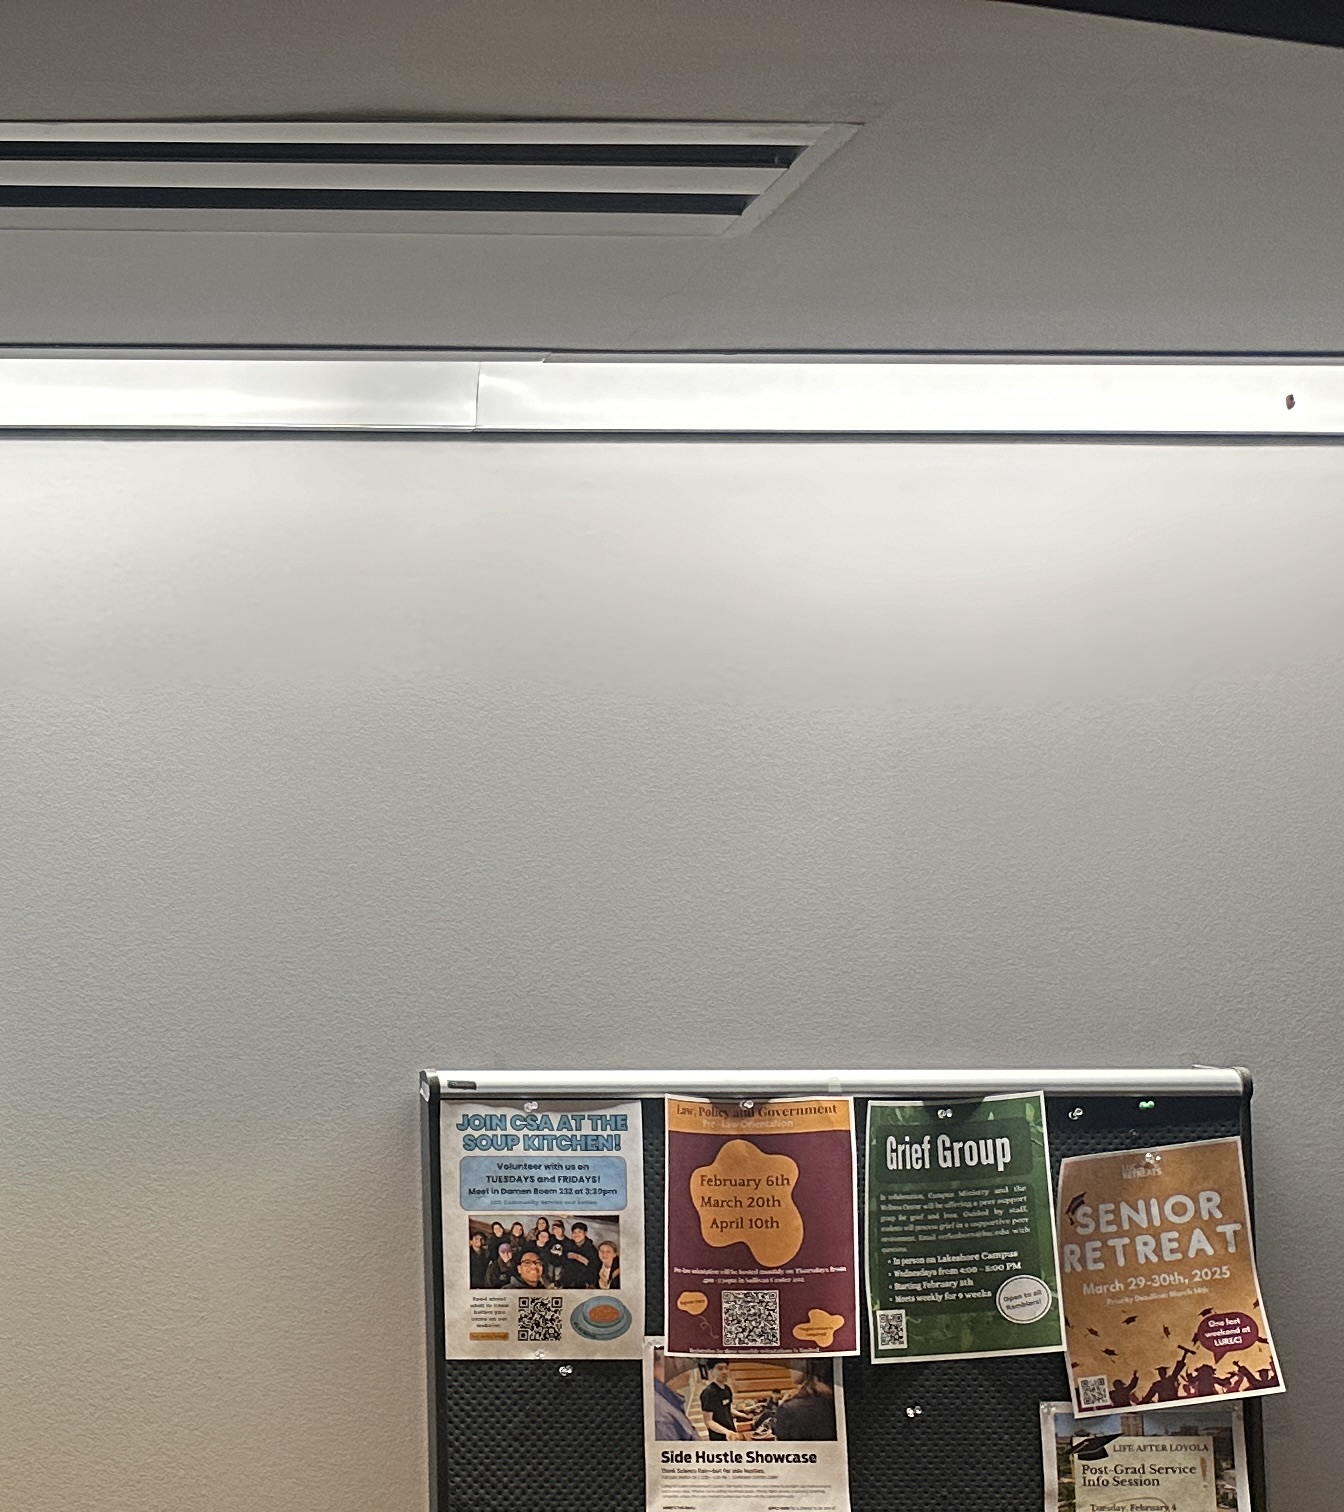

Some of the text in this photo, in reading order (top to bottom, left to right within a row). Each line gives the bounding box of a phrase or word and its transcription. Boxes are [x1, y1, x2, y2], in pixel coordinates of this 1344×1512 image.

[677, 1105, 696, 1117] Law,
[699, 1106, 728, 1119] Policy
[759, 1105, 837, 1117] Government
[457, 1114, 628, 1132] JOIN CSA AT THE
[463, 1135, 621, 1151] SOUP KITCHEN!
[887, 1134, 1011, 1172] Grief Group
[700, 1174, 790, 1190] February 6th
[701, 1196, 780, 1208] March 20th
[1076, 1191, 1222, 1235] SENIOR
[710, 1218, 779, 1232] April 10th
[1064, 1223, 1242, 1273] RETREAT
[938, 1254, 979, 1263] Lakeshore
[981, 1251, 1018, 1260] Campus
[894, 1269, 937, 1277] Wednesdays
[1006, 1262, 1021, 1270] PM
[894, 1282, 921, 1290] Starting
[923, 1280, 958, 1289] February
[1083, 1266, 1230, 1295] March 29-30th, 2025
[1208, 1318, 1240, 1328] One last
[1205, 1327, 1240, 1338] weekend
[1170, 1444, 1208, 1452] LOYOLA
[661, 1451, 817, 1463] Side Hustle Showcase
[1082, 1464, 1196, 1476] Post-Grad Service
[1082, 1477, 1160, 1486] Info Session
